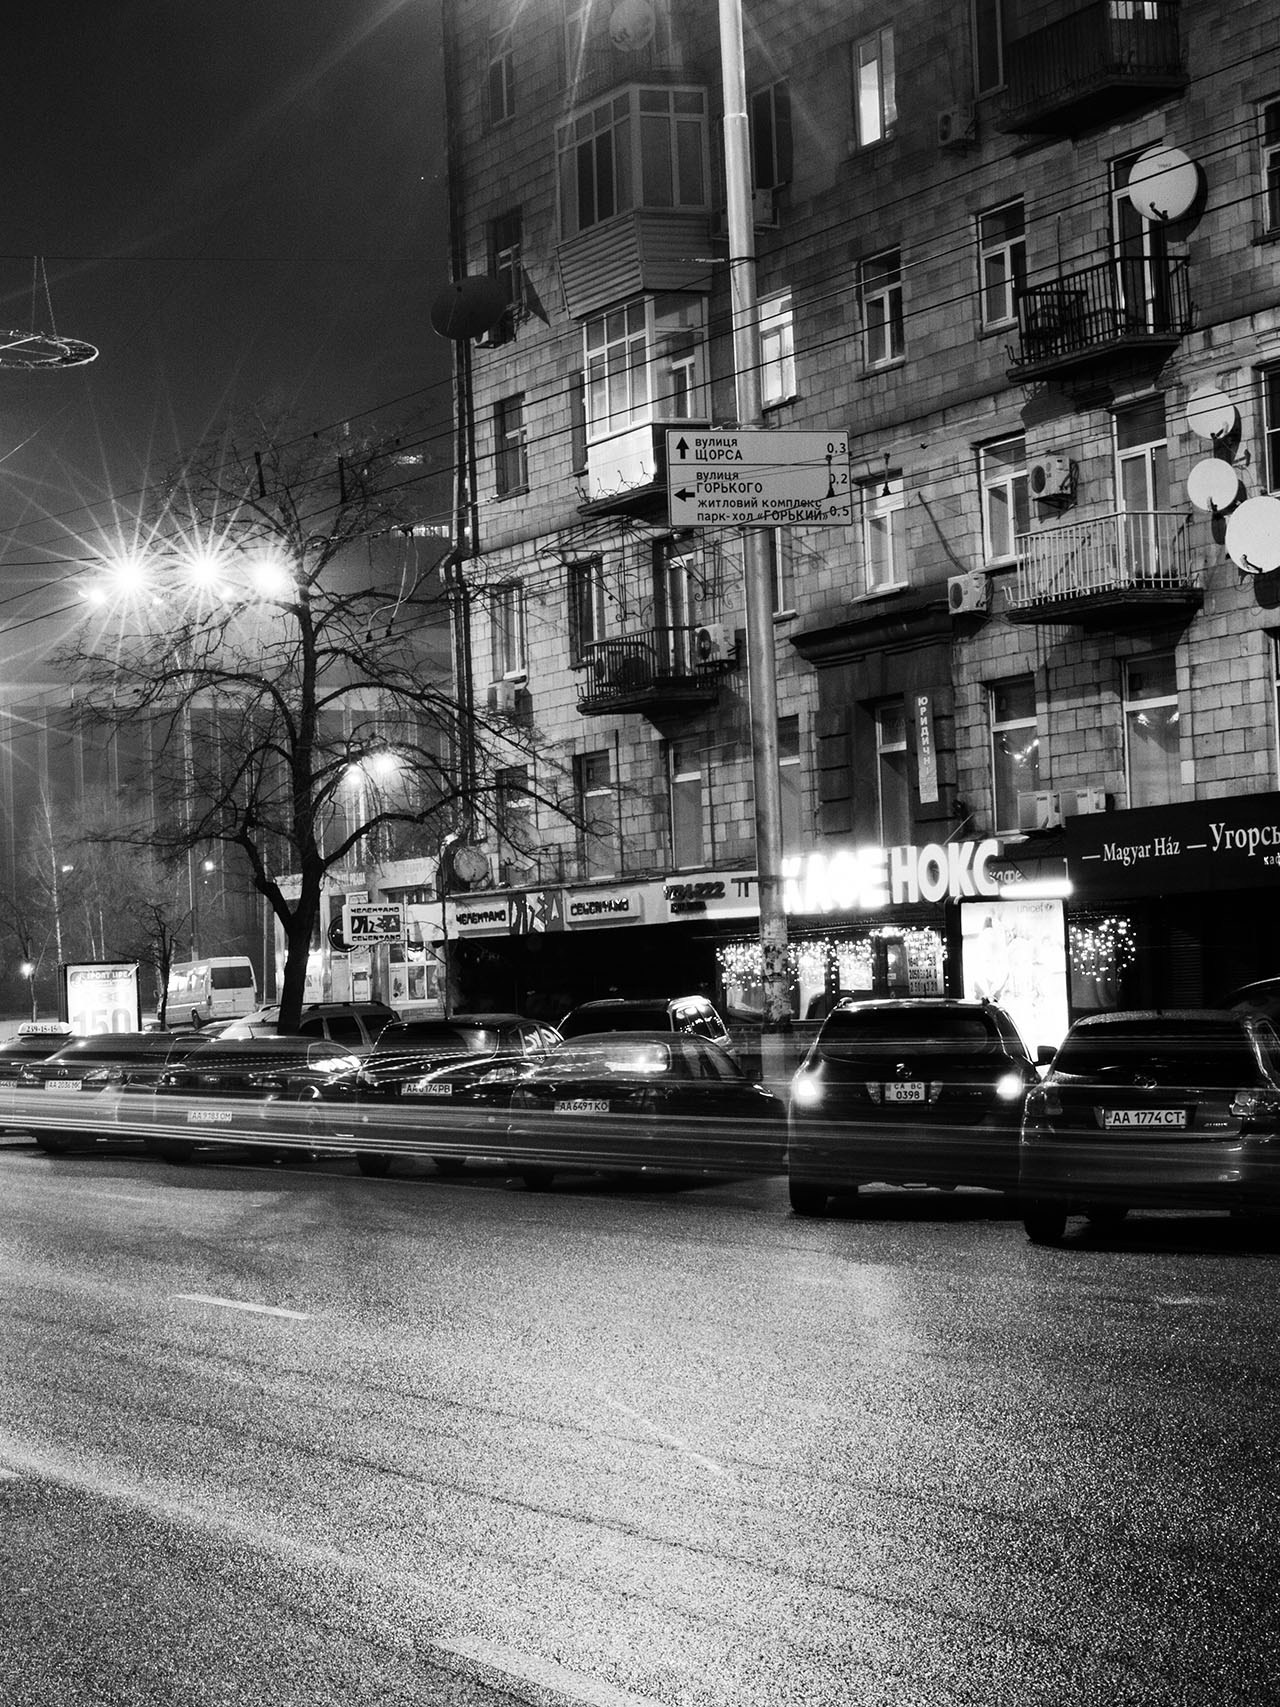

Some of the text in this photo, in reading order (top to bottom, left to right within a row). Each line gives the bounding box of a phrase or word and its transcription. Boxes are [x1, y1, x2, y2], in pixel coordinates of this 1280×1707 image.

[695, 438, 738, 449] вулиця
[695, 449, 743, 461] ЩОРСА
[696, 471, 739, 482] вулиця
[696, 482, 763, 493] ГОРЬКОГО
[697, 497, 822, 508] житловий комплекс
[697, 512, 753, 523] парк-хол
[1103, 836, 1181, 866] Magyar Ház
[890, 839, 999, 904] НОКС
[896, 1090, 920, 1100] 0398
[1112, 1111, 1183, 1124] AA 1774 CT
